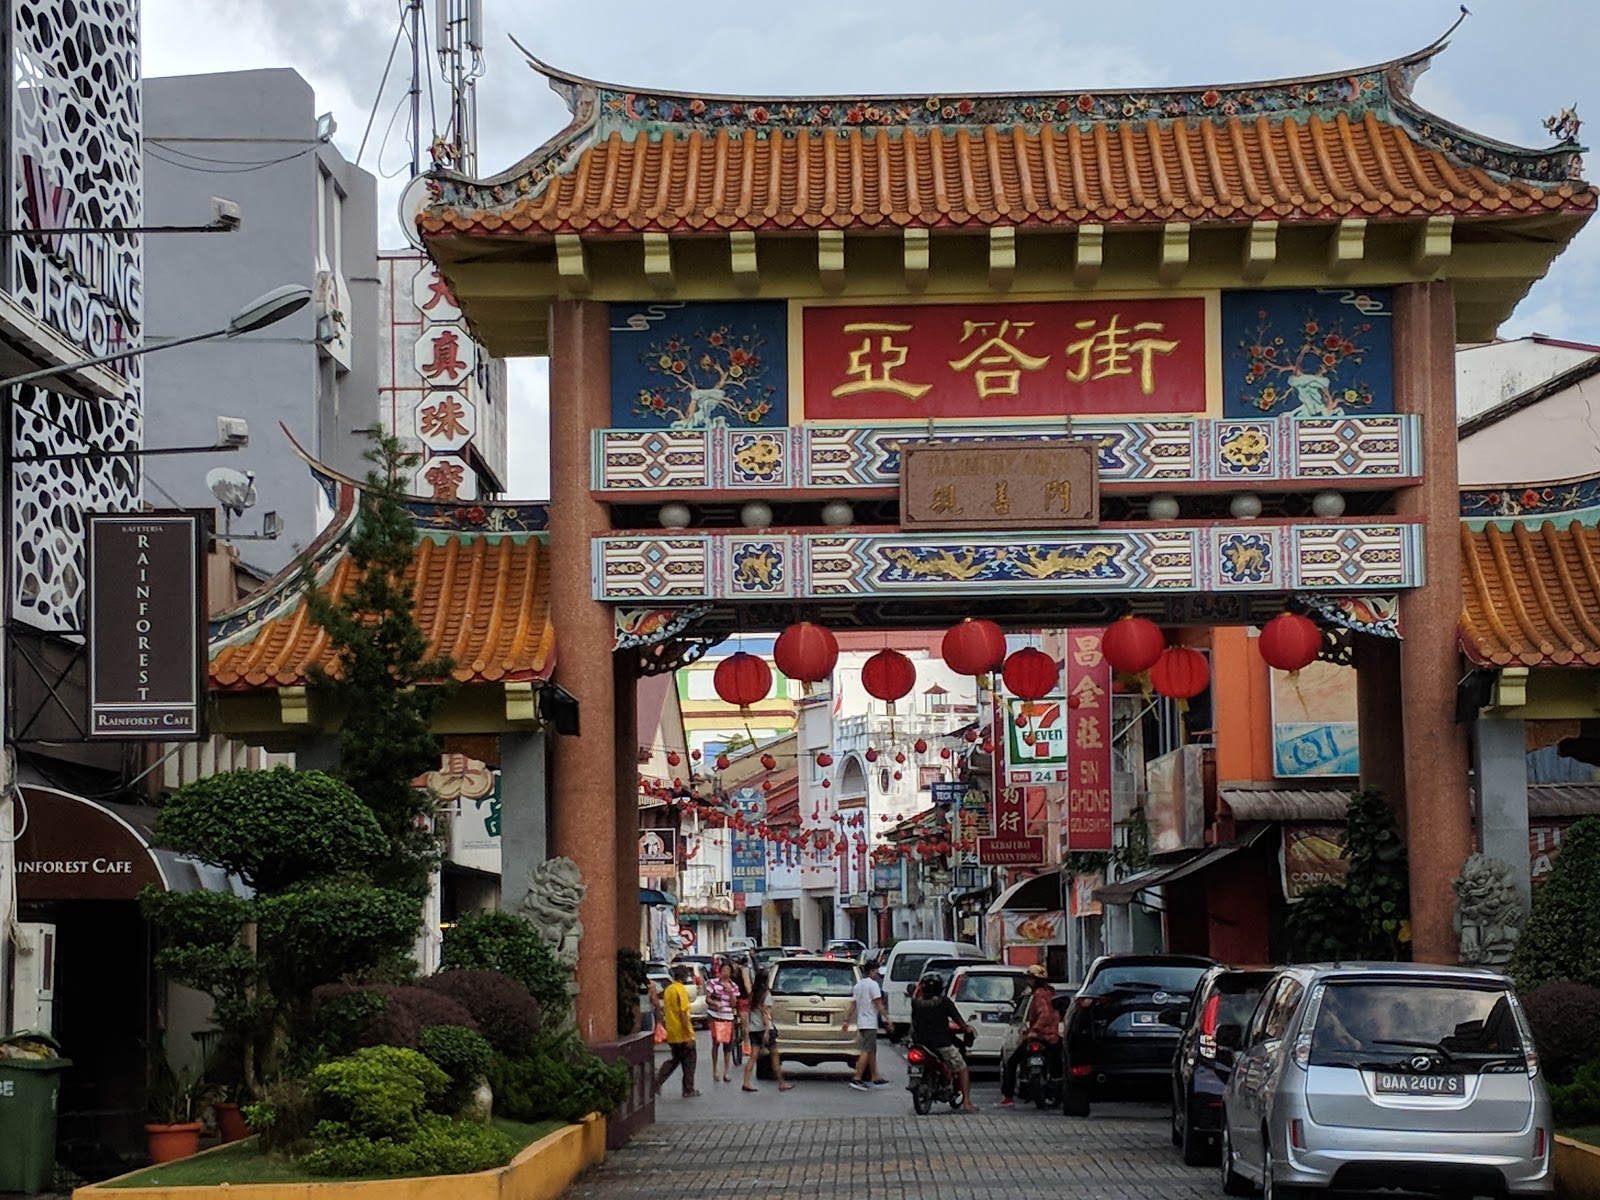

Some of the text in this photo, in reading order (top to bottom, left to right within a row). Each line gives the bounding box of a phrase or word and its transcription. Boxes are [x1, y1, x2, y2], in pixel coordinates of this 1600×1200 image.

[23, 155, 141, 325] WAITING
[831, 313, 1180, 400] 亞答街
[136, 535, 151, 700] RAINFOREST
[1036, 771, 1052, 781] 24
[1080, 760, 1100, 784] SIN
[1071, 789, 1110, 812] CHONG
[14, 861, 89, 873] INFOREST
[1382, 1075, 1458, 1091] QAA 2407 S
